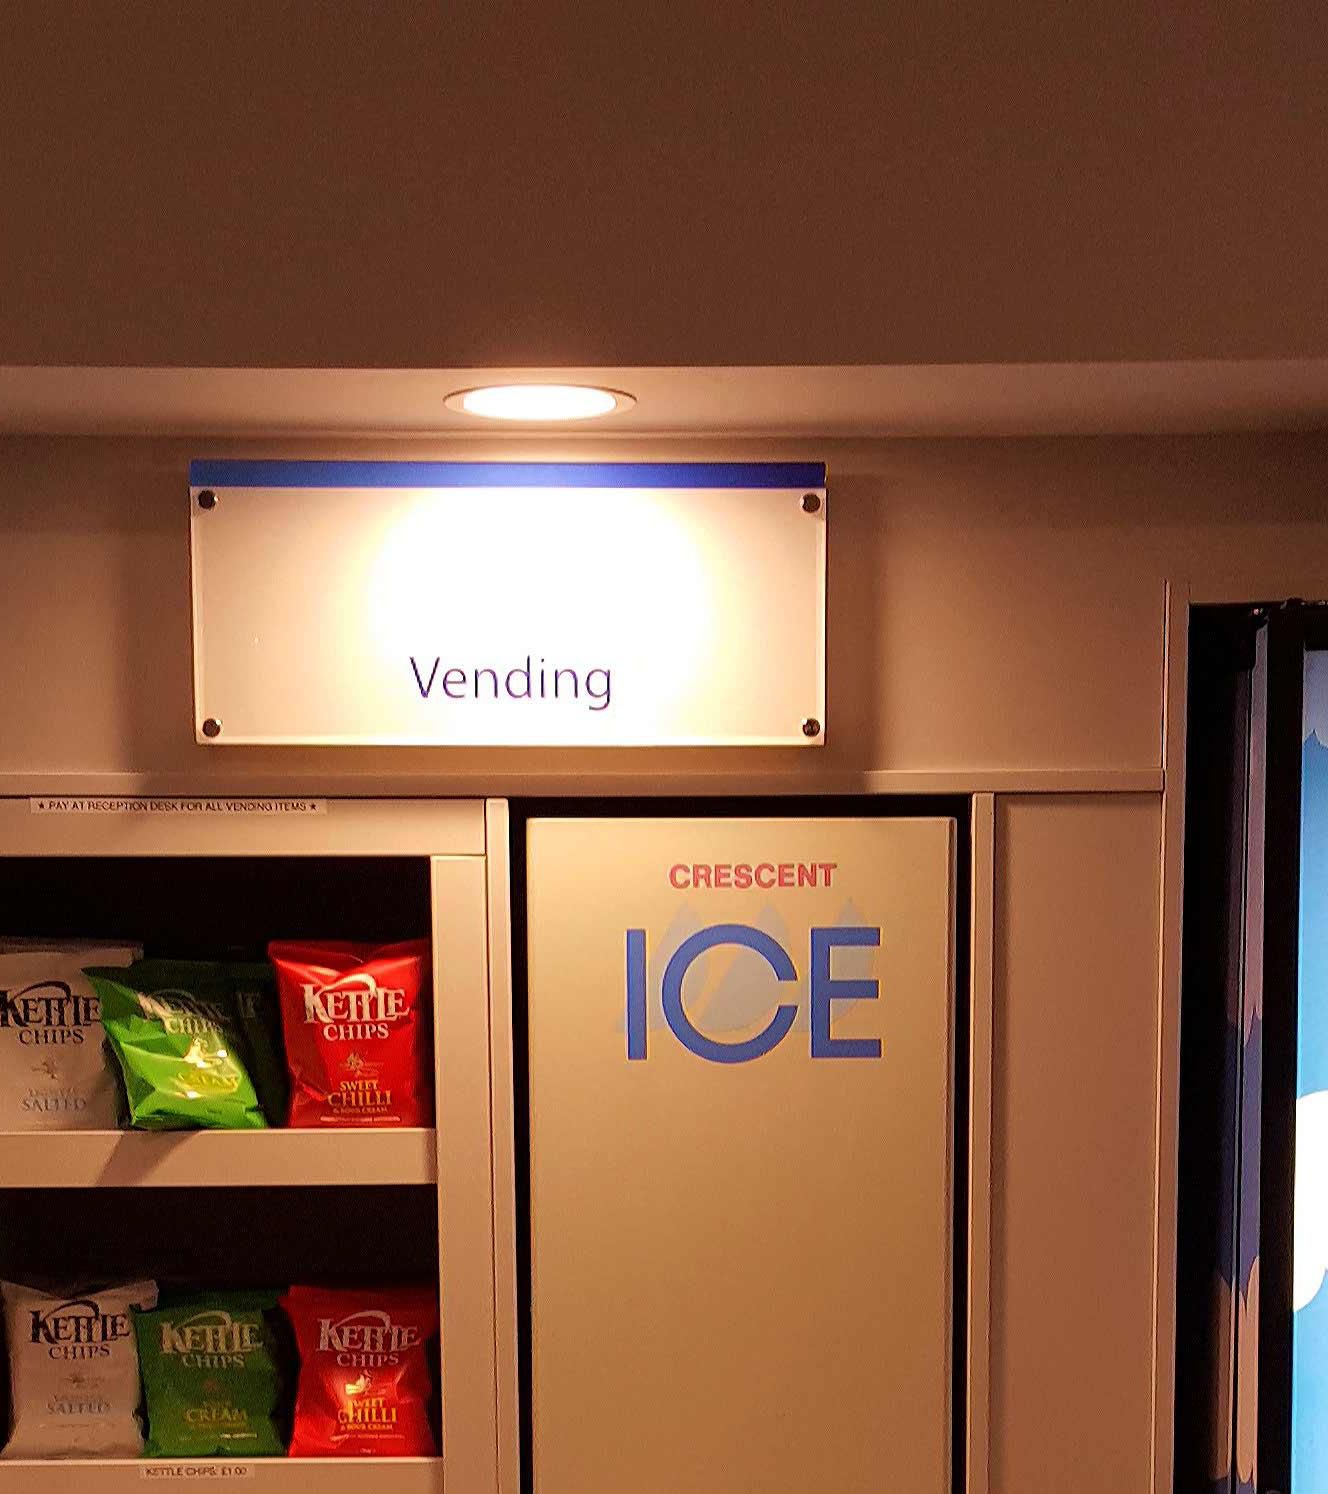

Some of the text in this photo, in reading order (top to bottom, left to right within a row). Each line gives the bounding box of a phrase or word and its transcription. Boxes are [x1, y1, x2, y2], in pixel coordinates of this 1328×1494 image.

[408, 654, 613, 711] Vending
[226, 802, 273, 811] VENDING
[274, 802, 307, 811] ITEMS
[668, 863, 838, 889] CRESCENT
[300, 973, 410, 1024] KETTLE
[626, 923, 882, 1064] ICE
[19, 1028, 85, 1045] CHIPS
[323, 1022, 390, 1042] CHIPS
[327, 1089, 392, 1106] CHILLI
[29, 1300, 130, 1344] KETTLE
[160, 1310, 264, 1354] KETTLE
[316, 1310, 421, 1352] KETTLE
[48, 1344, 111, 1360] CHIPS
[182, 1354, 245, 1369] CHIPS
[336, 1352, 400, 1368] CHIPS
[146, 1466, 184, 1476] KETTLE
[186, 1467, 216, 1476] CHIPS
